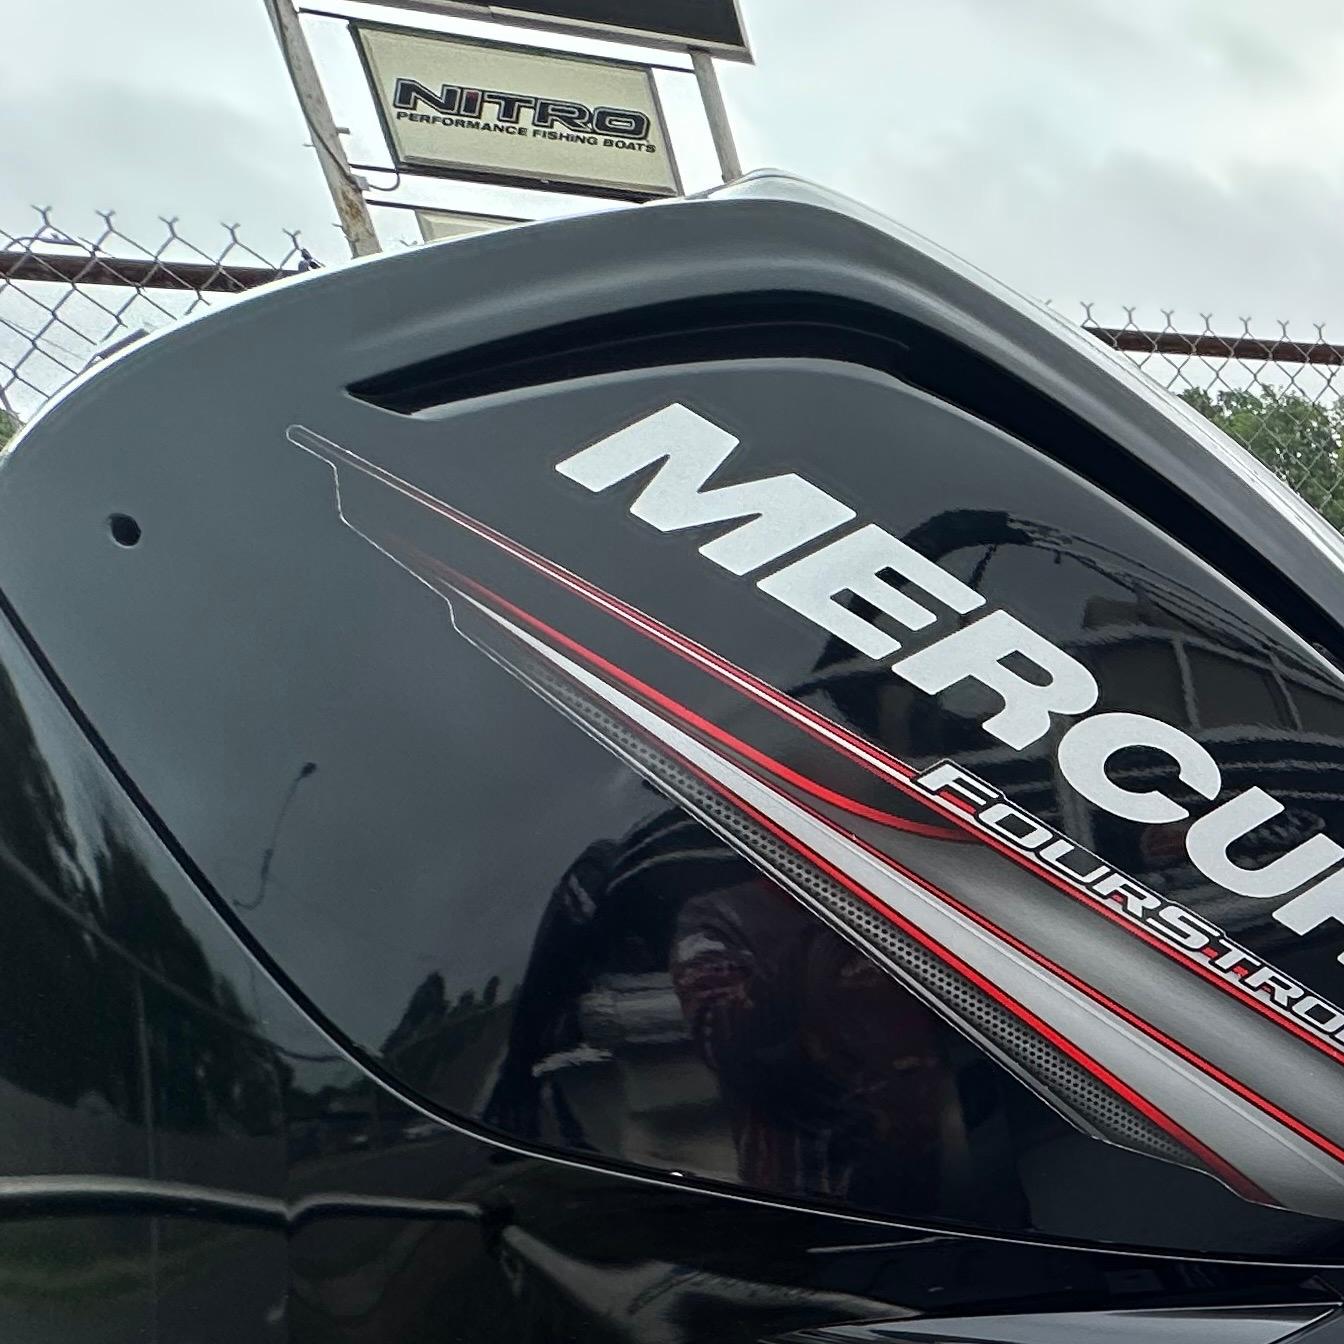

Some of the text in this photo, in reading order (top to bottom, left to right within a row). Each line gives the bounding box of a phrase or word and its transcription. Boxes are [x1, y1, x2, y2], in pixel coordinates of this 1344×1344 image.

[393, 77, 651, 140] NITRO
[396, 111, 657, 154] PERFORMANCE FISHING BOATS
